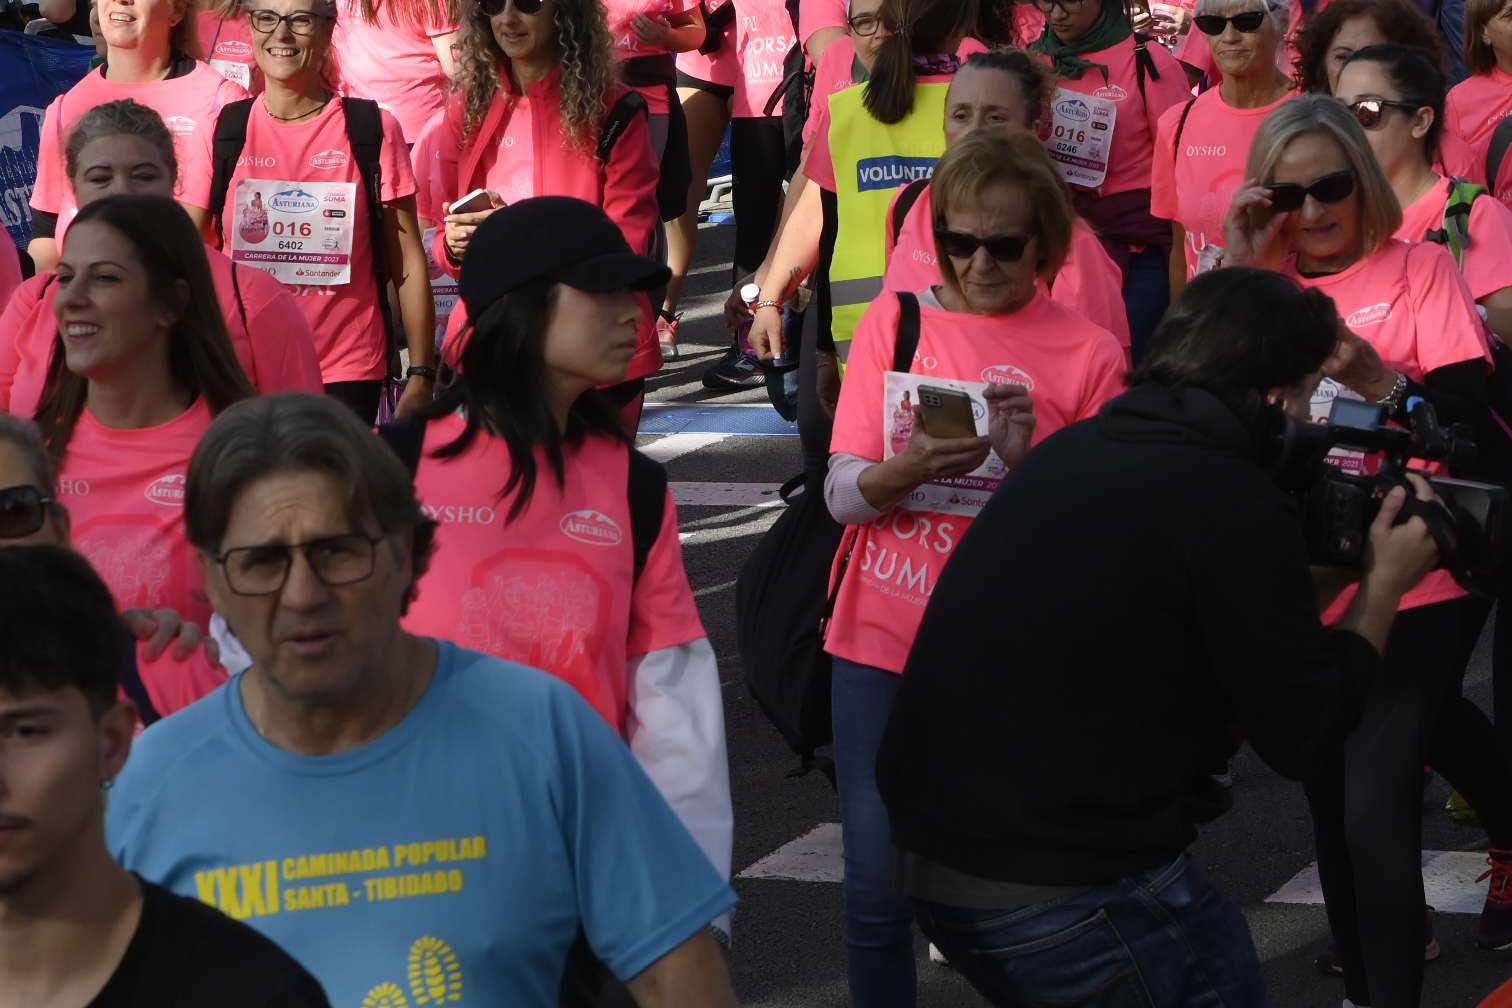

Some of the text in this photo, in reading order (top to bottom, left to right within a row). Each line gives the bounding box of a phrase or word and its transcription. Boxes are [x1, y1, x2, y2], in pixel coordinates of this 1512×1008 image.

[1054, 125, 1086, 143] 016
[1056, 142, 1078, 154] 6246
[1185, 145, 1227, 157] OYSHO
[271, 198, 315, 209] ASTURIANA
[323, 195, 346, 204] SUMA
[272, 221, 312, 237] 016
[278, 240, 303, 251] 6402
[244, 252, 340, 263] CARRERA DE LA MUJER 2023
[304, 269, 341, 278] Santander
[954, 478, 984, 488] MUJER
[420, 504, 496, 525] YSHO
[565, 517, 618, 540] ASTURIANA
[860, 540, 936, 597] SUM
[282, 835, 487, 881] CAMINADA POPULAR
[194, 859, 281, 921] XXXI
[283, 882, 350, 912] SANTA
[363, 868, 464, 904] TIBIDABO
